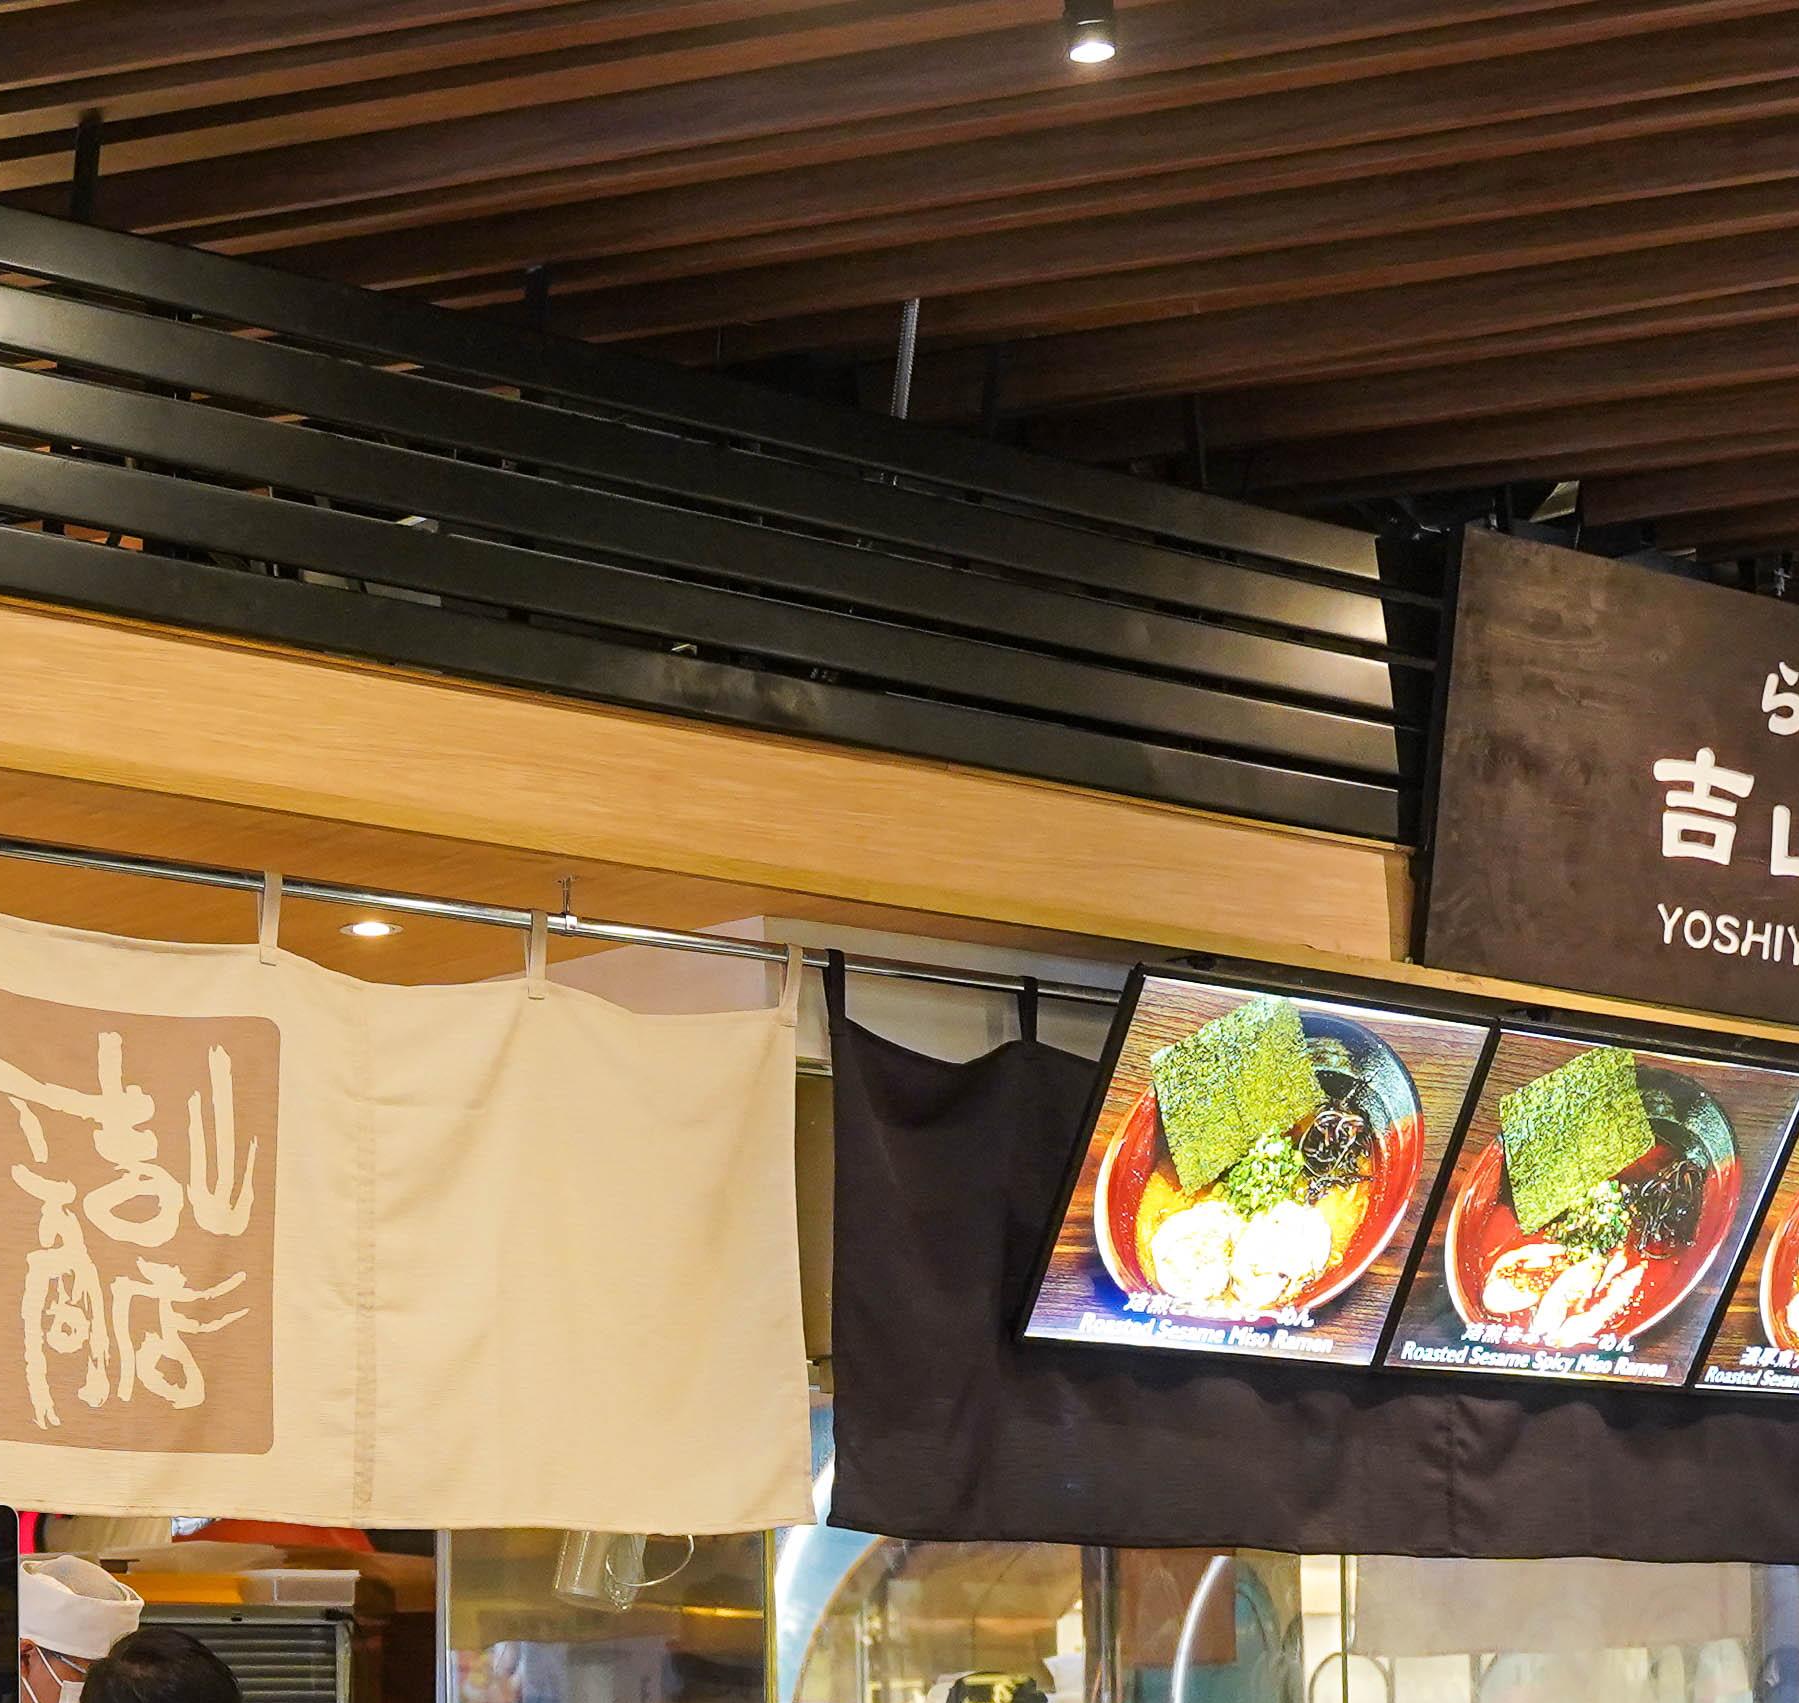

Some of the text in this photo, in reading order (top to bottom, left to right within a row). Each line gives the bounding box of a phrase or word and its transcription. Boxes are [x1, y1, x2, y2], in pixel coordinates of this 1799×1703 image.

[1079, 1311, 1334, 1354] Roasted Sesame Miso Ramen
[1401, 1341, 1668, 1379] Roasted Sesame Spicy Miso Ramen
[1704, 1366, 1760, 1385] Roasted
